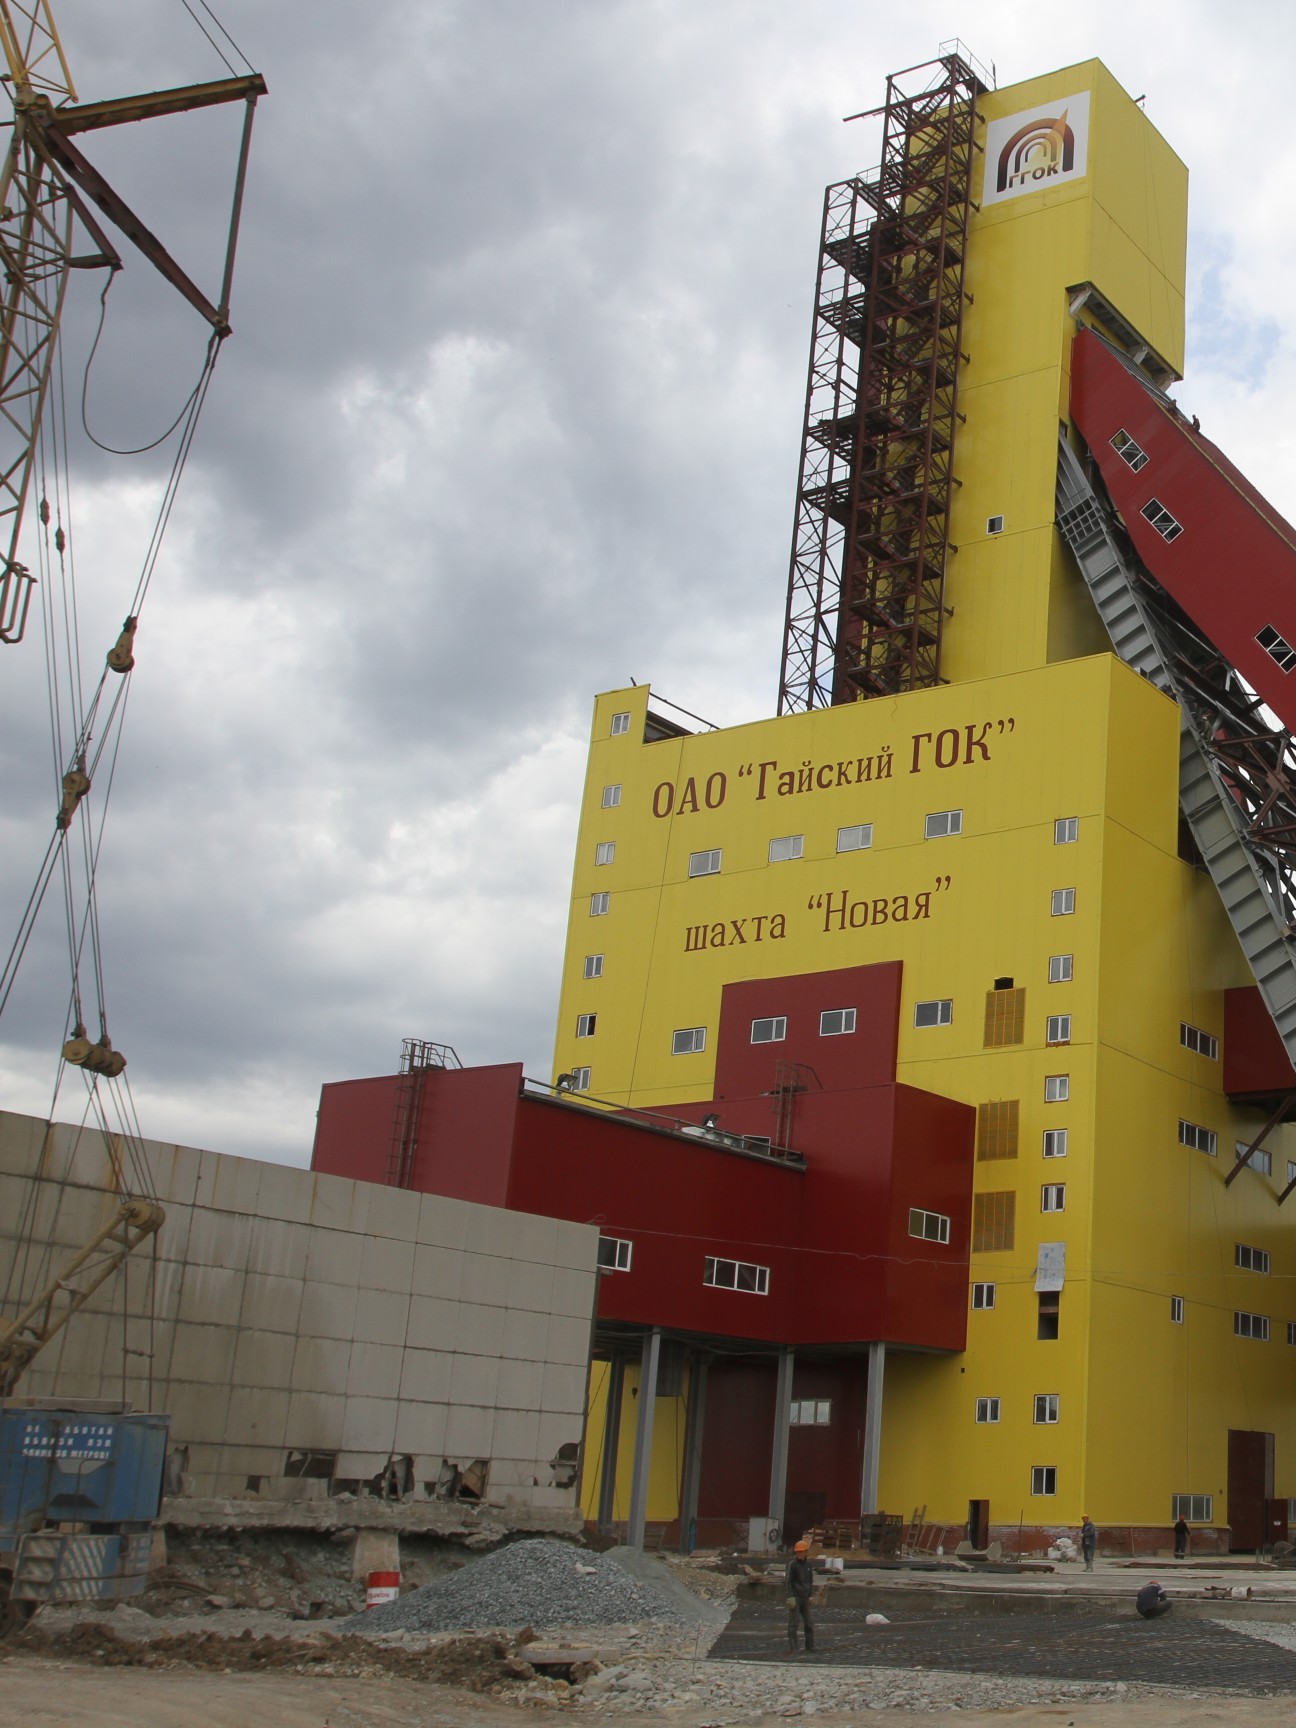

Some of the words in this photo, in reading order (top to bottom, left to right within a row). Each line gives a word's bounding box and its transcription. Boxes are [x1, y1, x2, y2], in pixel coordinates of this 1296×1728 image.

[1008, 161, 1059, 188] ГГОК
[652, 771, 728, 819] ОАО
[738, 745, 894, 801] “Гайский
[909, 717, 1015, 774] ГОК”
[684, 912, 786, 953] шахта
[64, 1426, 113, 1435] АБОТАЙ
